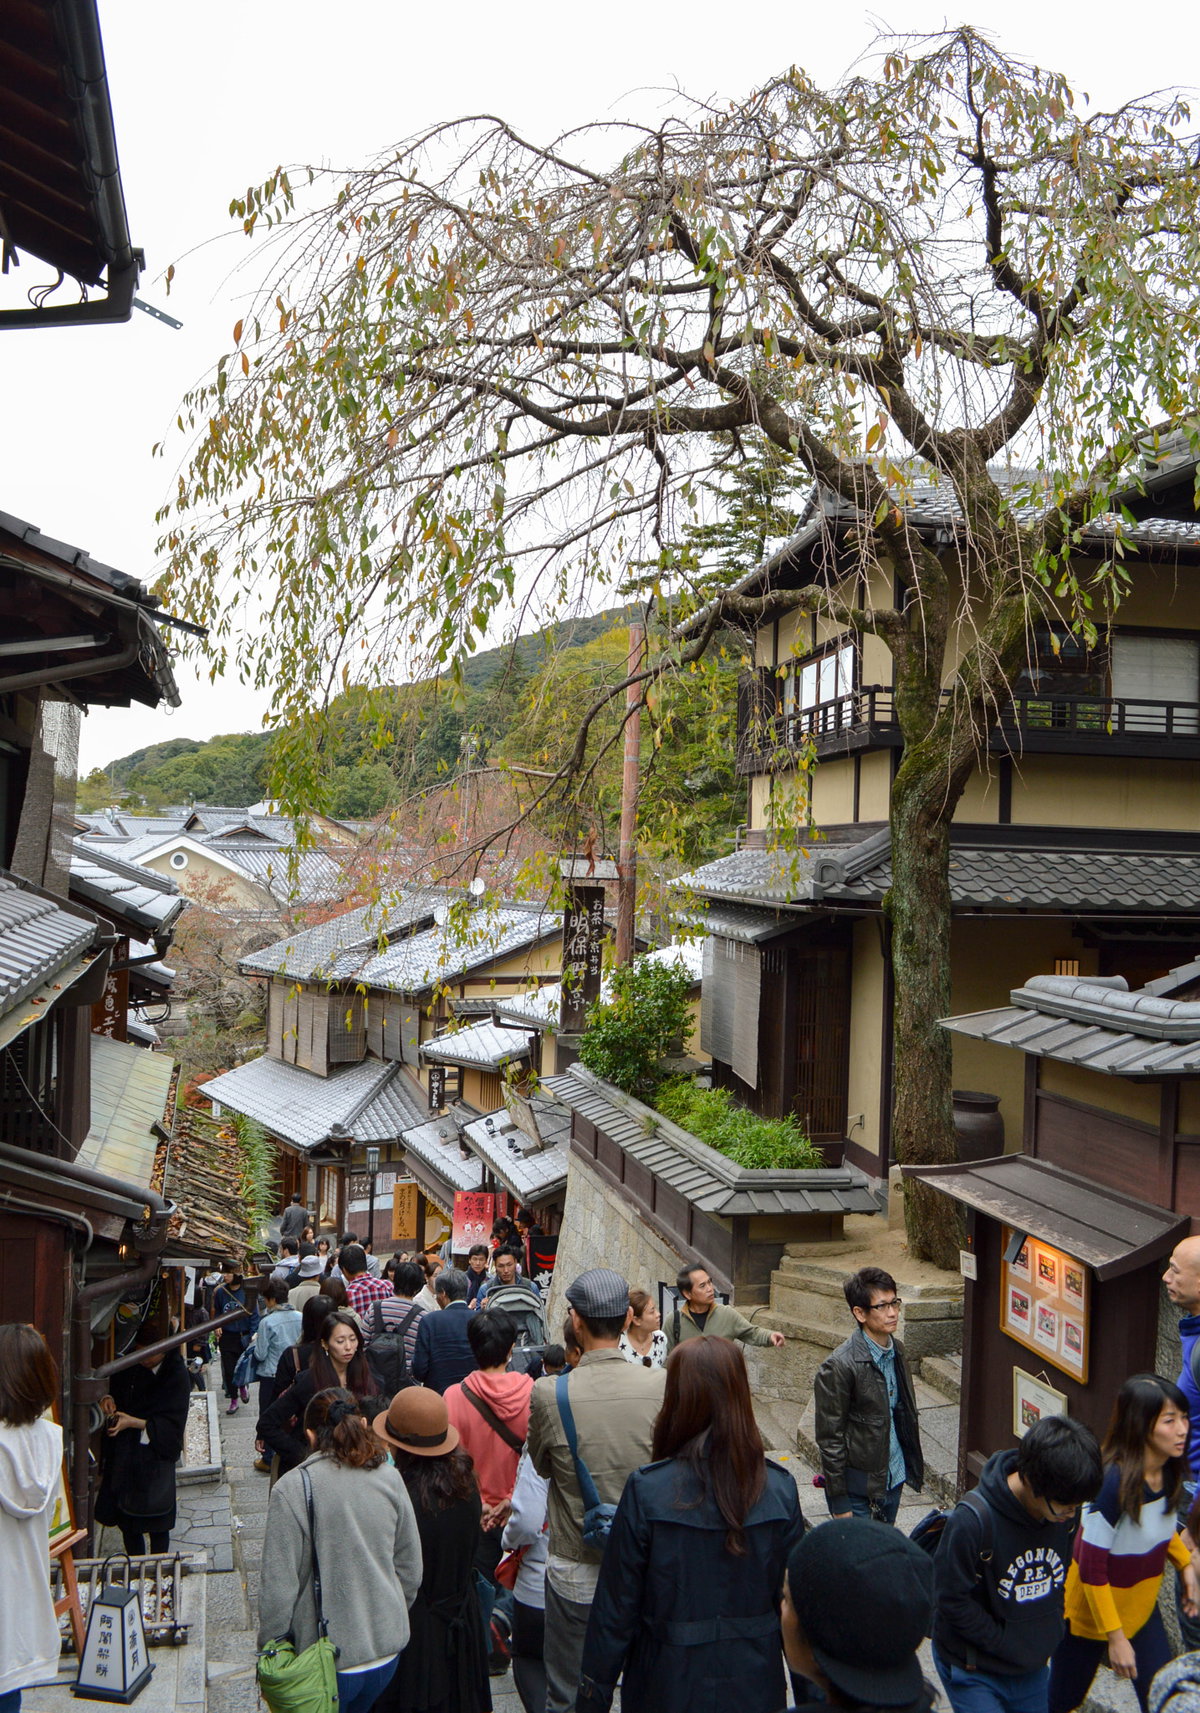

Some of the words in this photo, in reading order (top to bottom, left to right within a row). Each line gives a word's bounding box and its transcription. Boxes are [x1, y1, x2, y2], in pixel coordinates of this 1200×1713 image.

[568, 910, 591, 1012] 明保野亭
[997, 1547, 1045, 1599] OREGON
[1019, 1581, 1048, 1598] DEPT
[1023, 1565, 1047, 1582] P.E.
[95, 1614, 114, 1678] 阿闍梨餅
